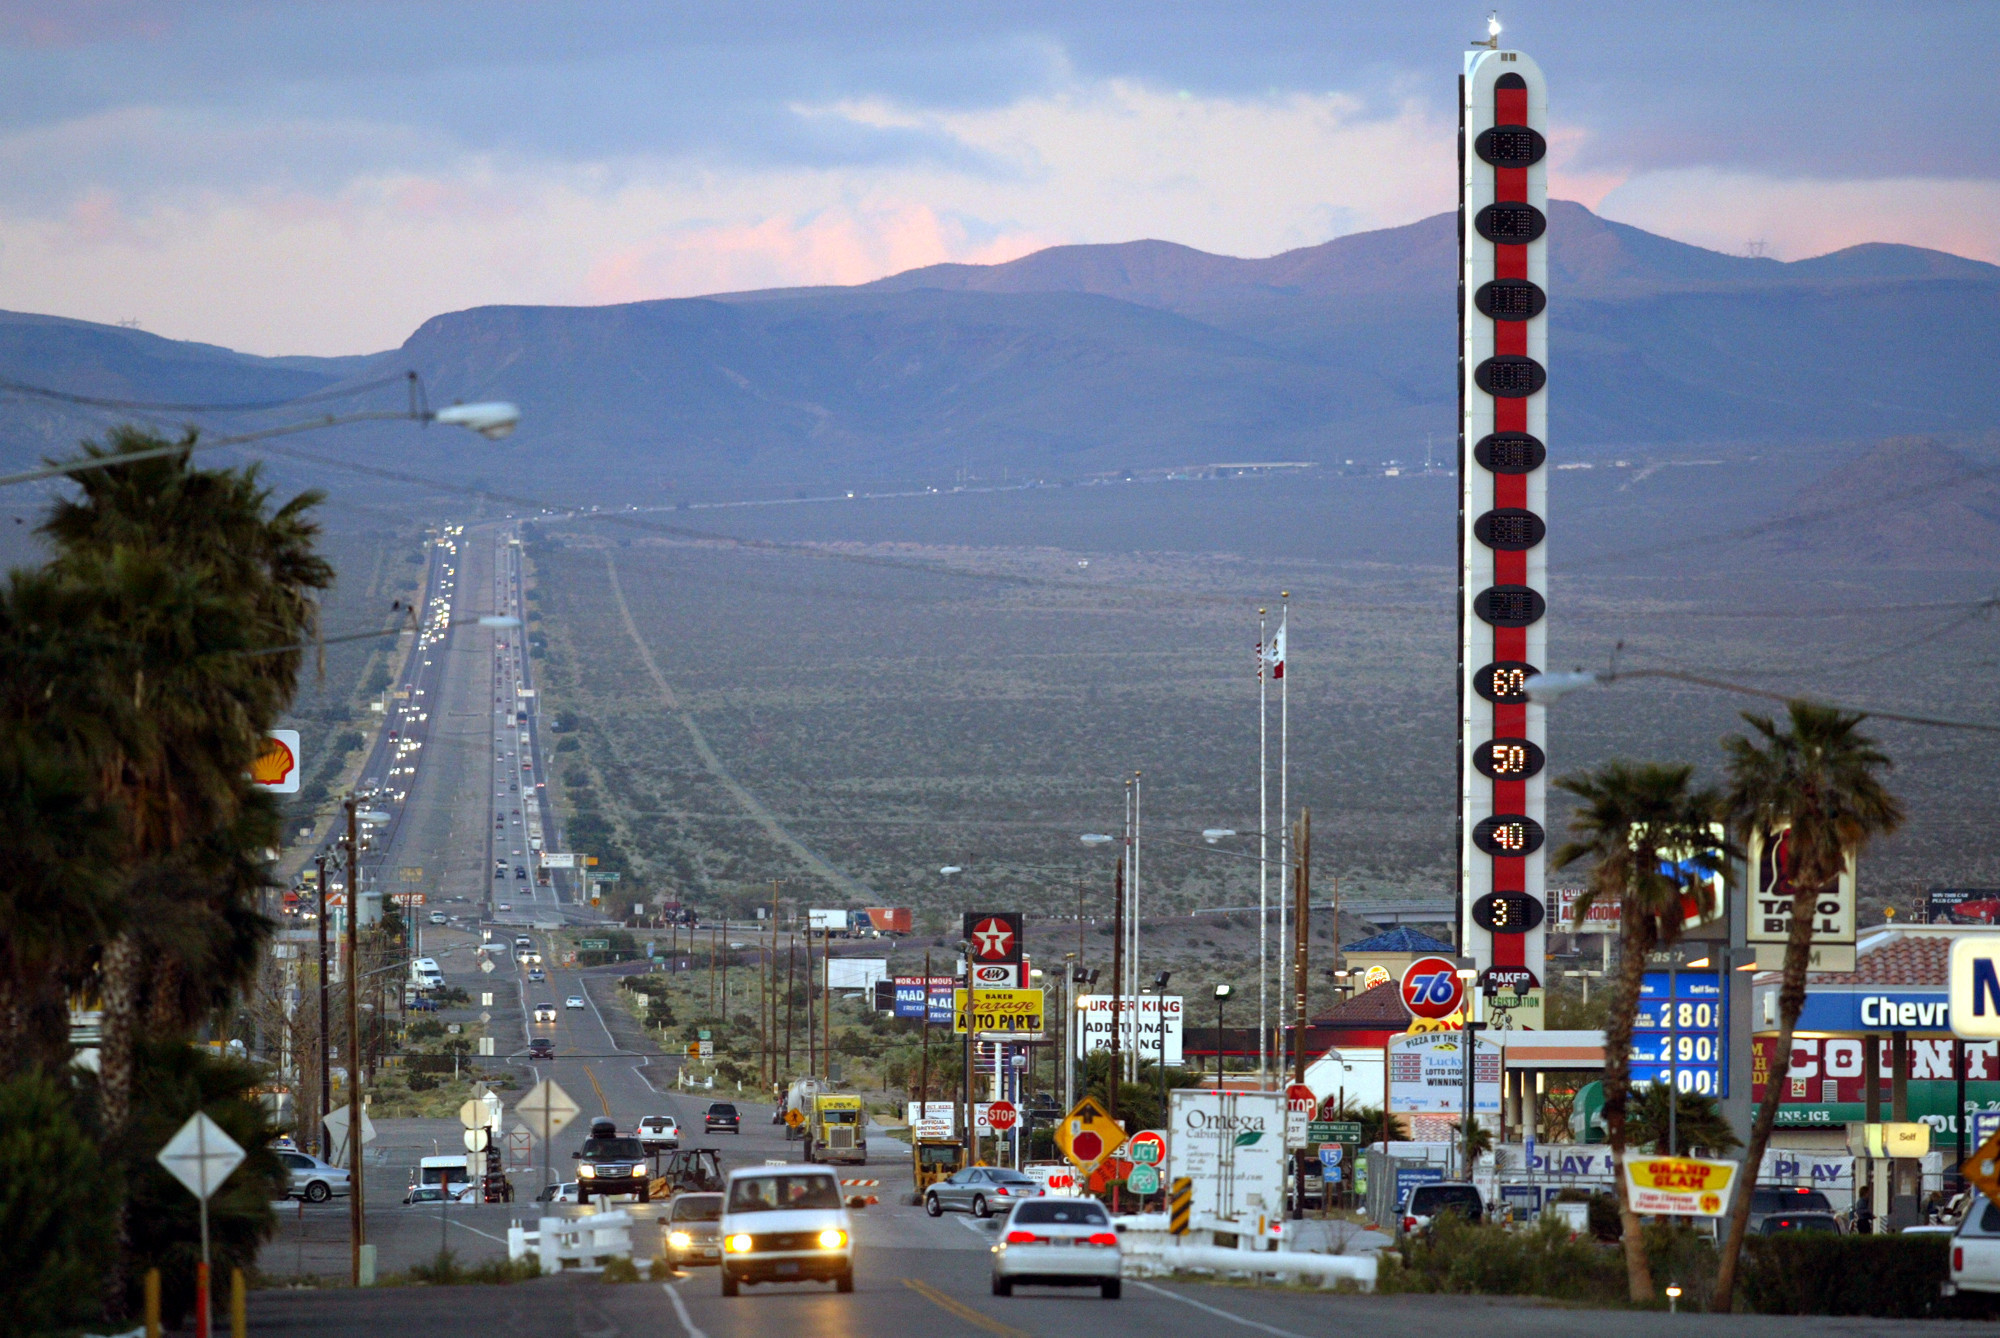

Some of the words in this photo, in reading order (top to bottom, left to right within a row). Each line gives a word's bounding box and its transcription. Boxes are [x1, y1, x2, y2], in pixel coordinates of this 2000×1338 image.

[1493, 669, 1524, 696] 60
[1493, 745, 1524, 773] 50
[1493, 822, 1524, 849] 40
[1562, 905, 1577, 921] AL
[1587, 905, 1621, 921] ROOM
[1758, 900, 1841, 915] TAO
[895, 977, 921, 985] WORLD
[1489, 972, 1530, 984] BAKER
[1409, 971, 1455, 1005] 76
[1704, 985, 1720, 993] Serv
[896, 990, 925, 1001] MAD
[962, 998, 1036, 1014] Garage
[1089, 1000, 1135, 1012] URGER
[1142, 1000, 1180, 1012] KING
[1860, 996, 1948, 1026] Chevr
[1086, 1022, 1173, 1034] ADDTIONAL
[1095, 1038, 1160, 1050] PAKNG
[1405, 1036, 1428, 1049] PIZZA
[1431, 1034, 1441, 1043] BY
[1443, 1034, 1458, 1043] THE
[1461, 1036, 1484, 1049] SCE
[1793, 1083, 1805, 1091] 24
[1288, 1098, 1315, 1112] TOP
[988, 1109, 1016, 1121] STOP
[1186, 1109, 1265, 1135] Omega
[1808, 1110, 1830, 1121] ICE
[1899, 1132, 1917, 1141] Self
[1134, 1146, 1156, 1160] JCT
[1325, 1151, 1338, 1163] 15
[1531, 1155, 1595, 1175] PLAY
[1648, 1162, 1711, 1177] GRAND
[1402, 1188, 1410, 1201] 2
